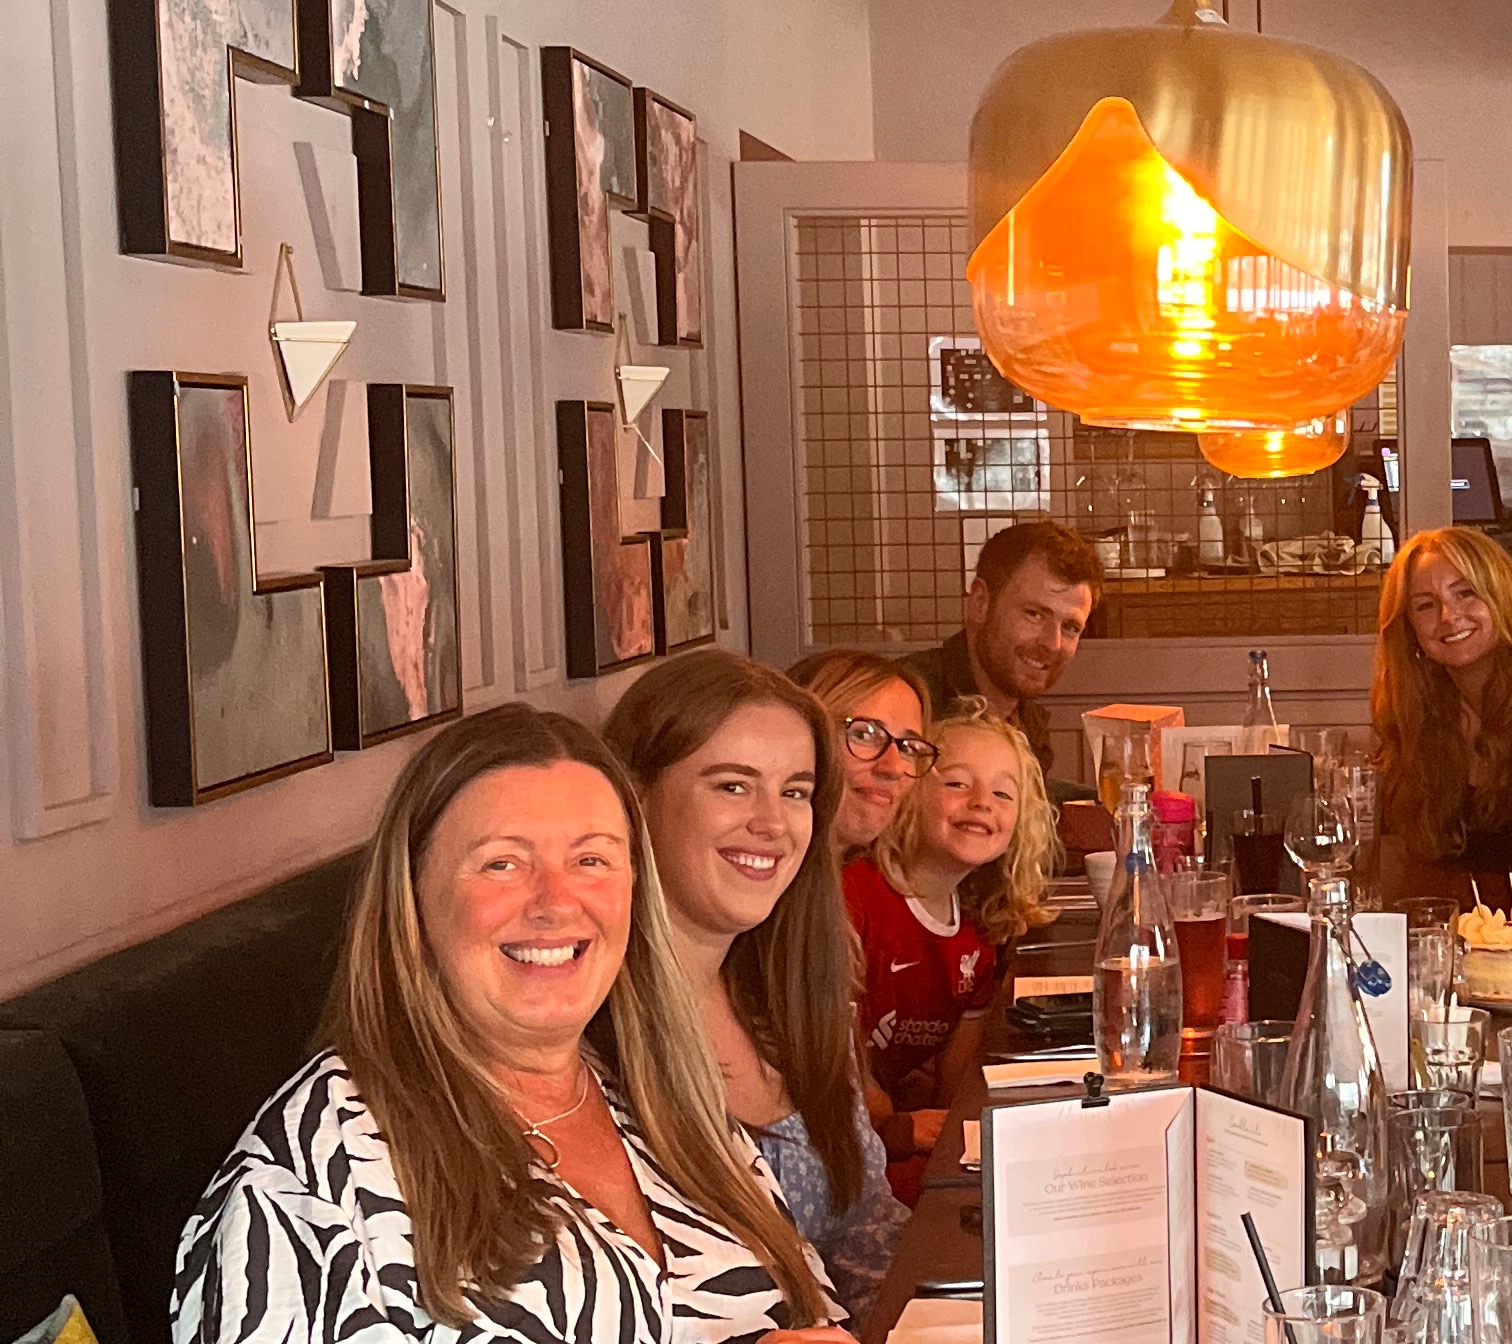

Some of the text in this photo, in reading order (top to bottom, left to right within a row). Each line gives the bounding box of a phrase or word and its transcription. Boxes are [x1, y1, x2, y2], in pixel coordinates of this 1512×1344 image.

[1044, 1182, 1065, 1195] Our
[1067, 1178, 1098, 1191] Wine
[1099, 1171, 1149, 1187] Selection
[1054, 1273, 1144, 1295] Drinks Packages
